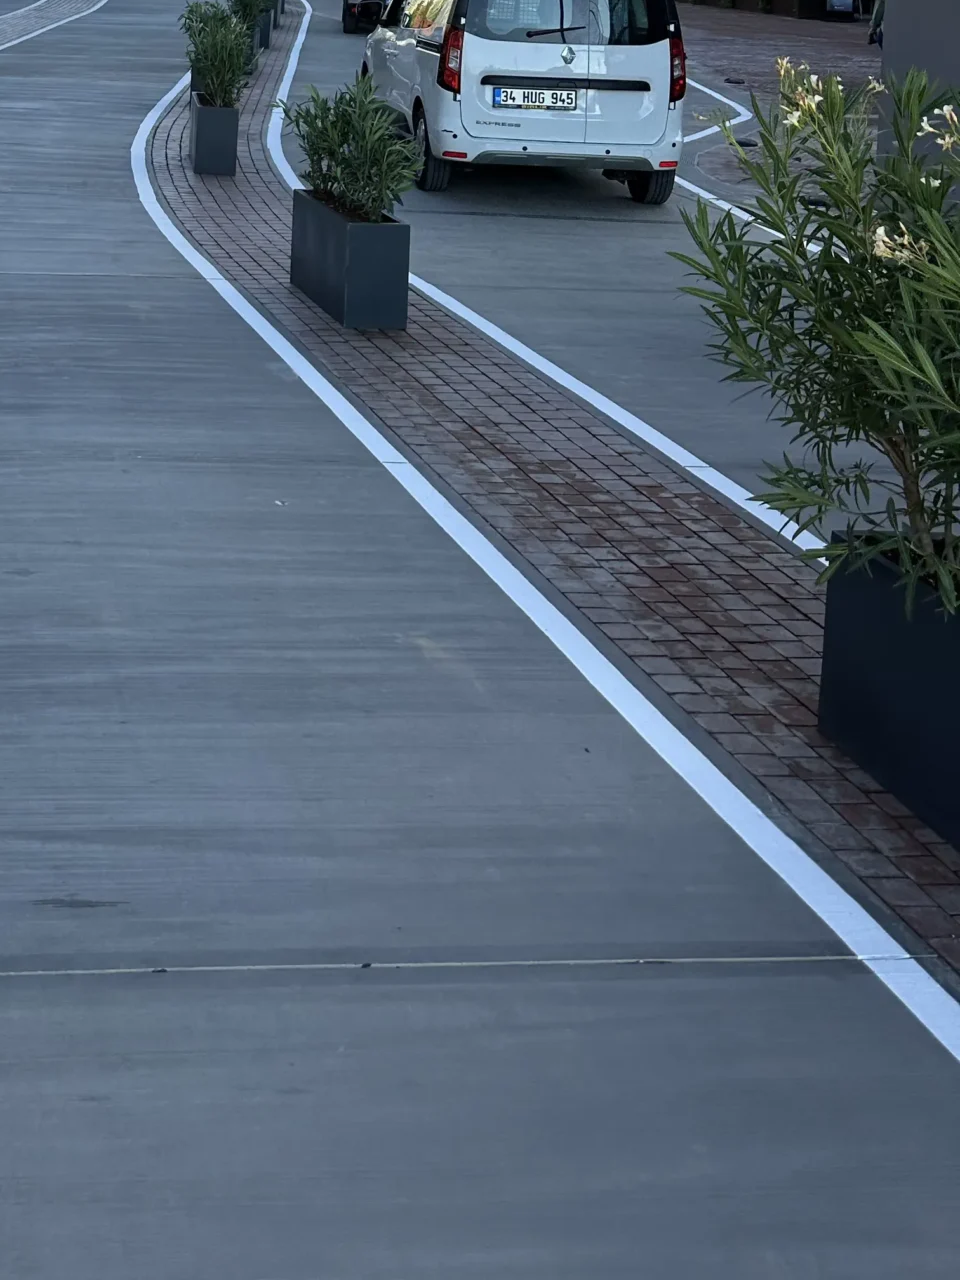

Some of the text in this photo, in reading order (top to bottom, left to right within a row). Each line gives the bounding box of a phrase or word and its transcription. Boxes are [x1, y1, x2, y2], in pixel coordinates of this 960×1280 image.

[501, 90, 574, 105] 34 HUG 945
